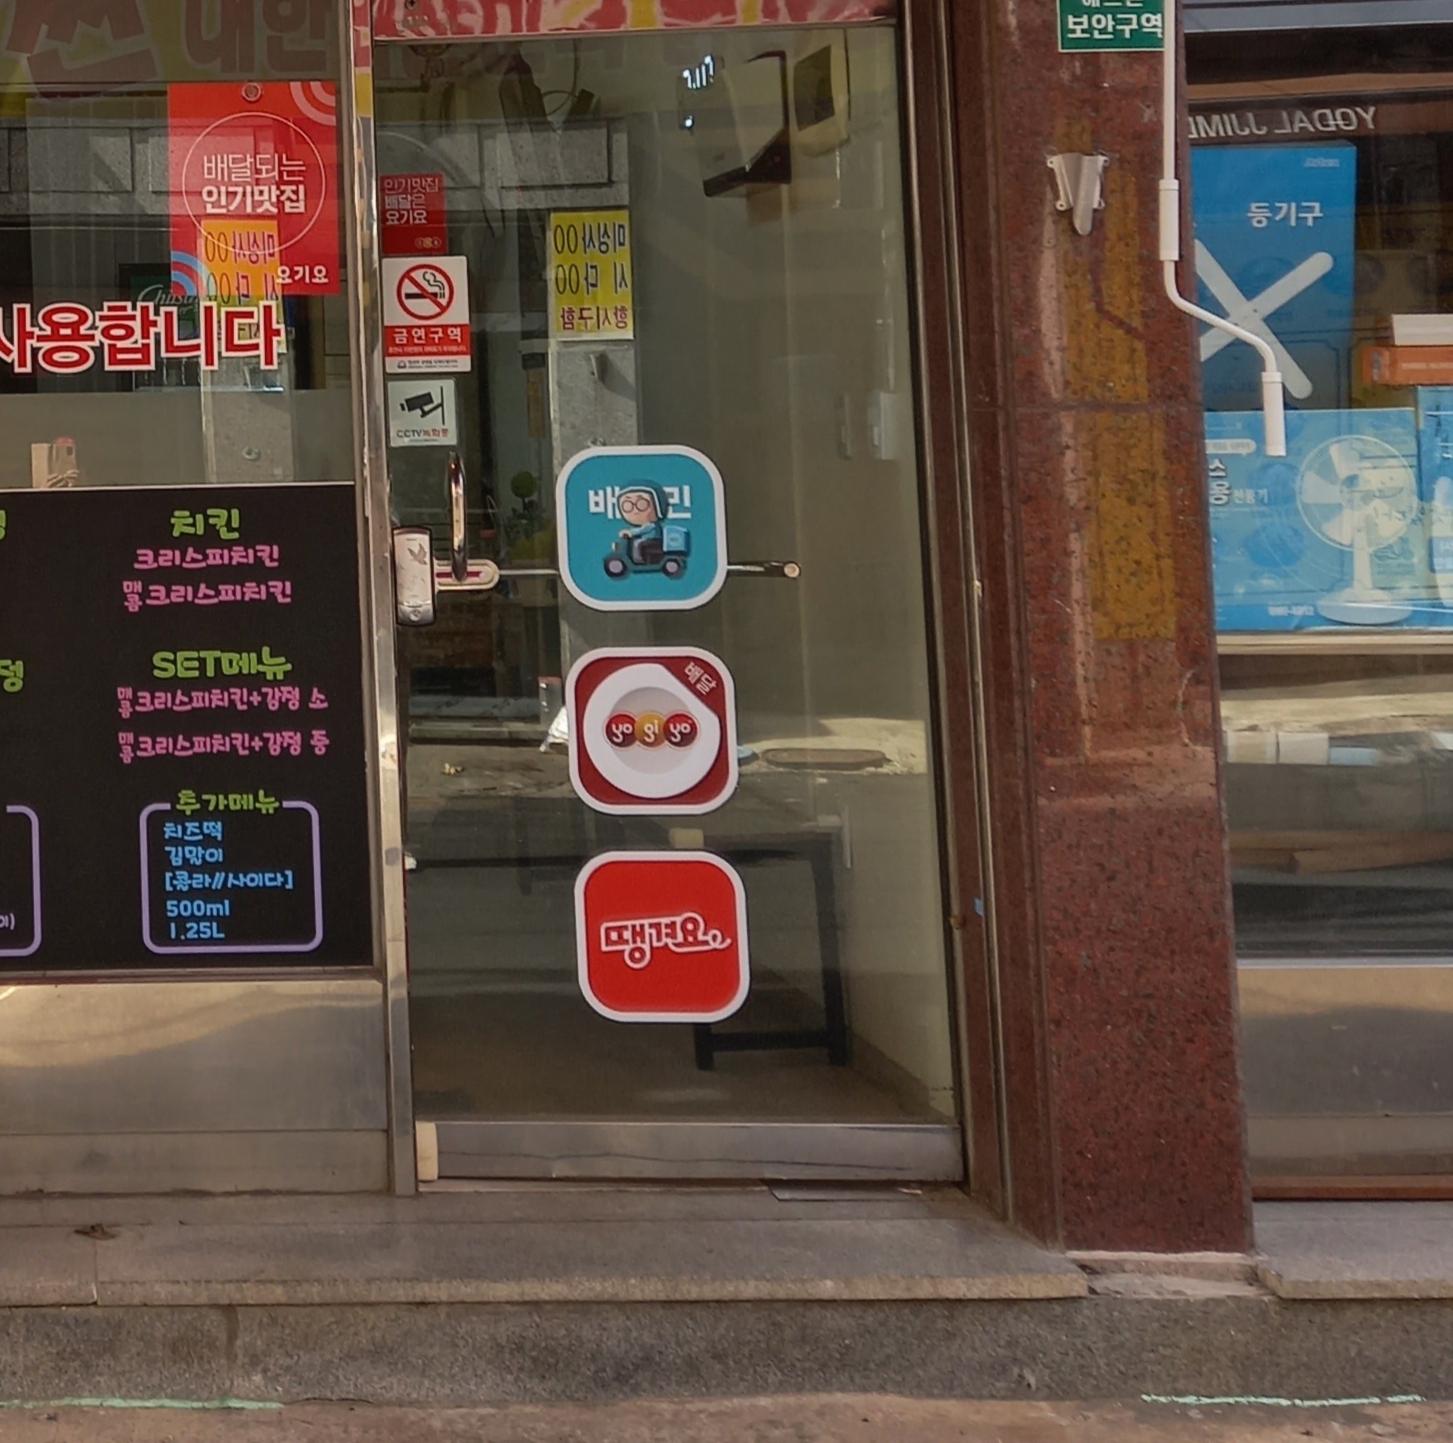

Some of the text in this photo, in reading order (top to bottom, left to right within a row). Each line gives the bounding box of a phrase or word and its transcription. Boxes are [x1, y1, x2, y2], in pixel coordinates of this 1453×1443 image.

[1066, 12, 1163, 39] 보안구역
[203, 153, 307, 182] 배달되는
[384, 177, 439, 194] 인기맛집
[201, 184, 306, 214] 인기맛집
[386, 209, 428, 225] 요기요
[1247, 201, 1324, 228] 등기구
[276, 265, 329, 284] 요기요
[393, 327, 462, 345] 금연구역
[170, 508, 240, 540] 치킨
[133, 544, 280, 569] 크리스피치킨
[152, 646, 293, 680] SET메뉴
[684, 661, 718, 696] 배달
[175, 789, 281, 816] 추가메뉴
[163, 821, 223, 841] 치즈떡
[164, 846, 224, 866] 김말이
[166, 900, 230, 918] 500ml
[170, 922, 225, 940] 1.25L
